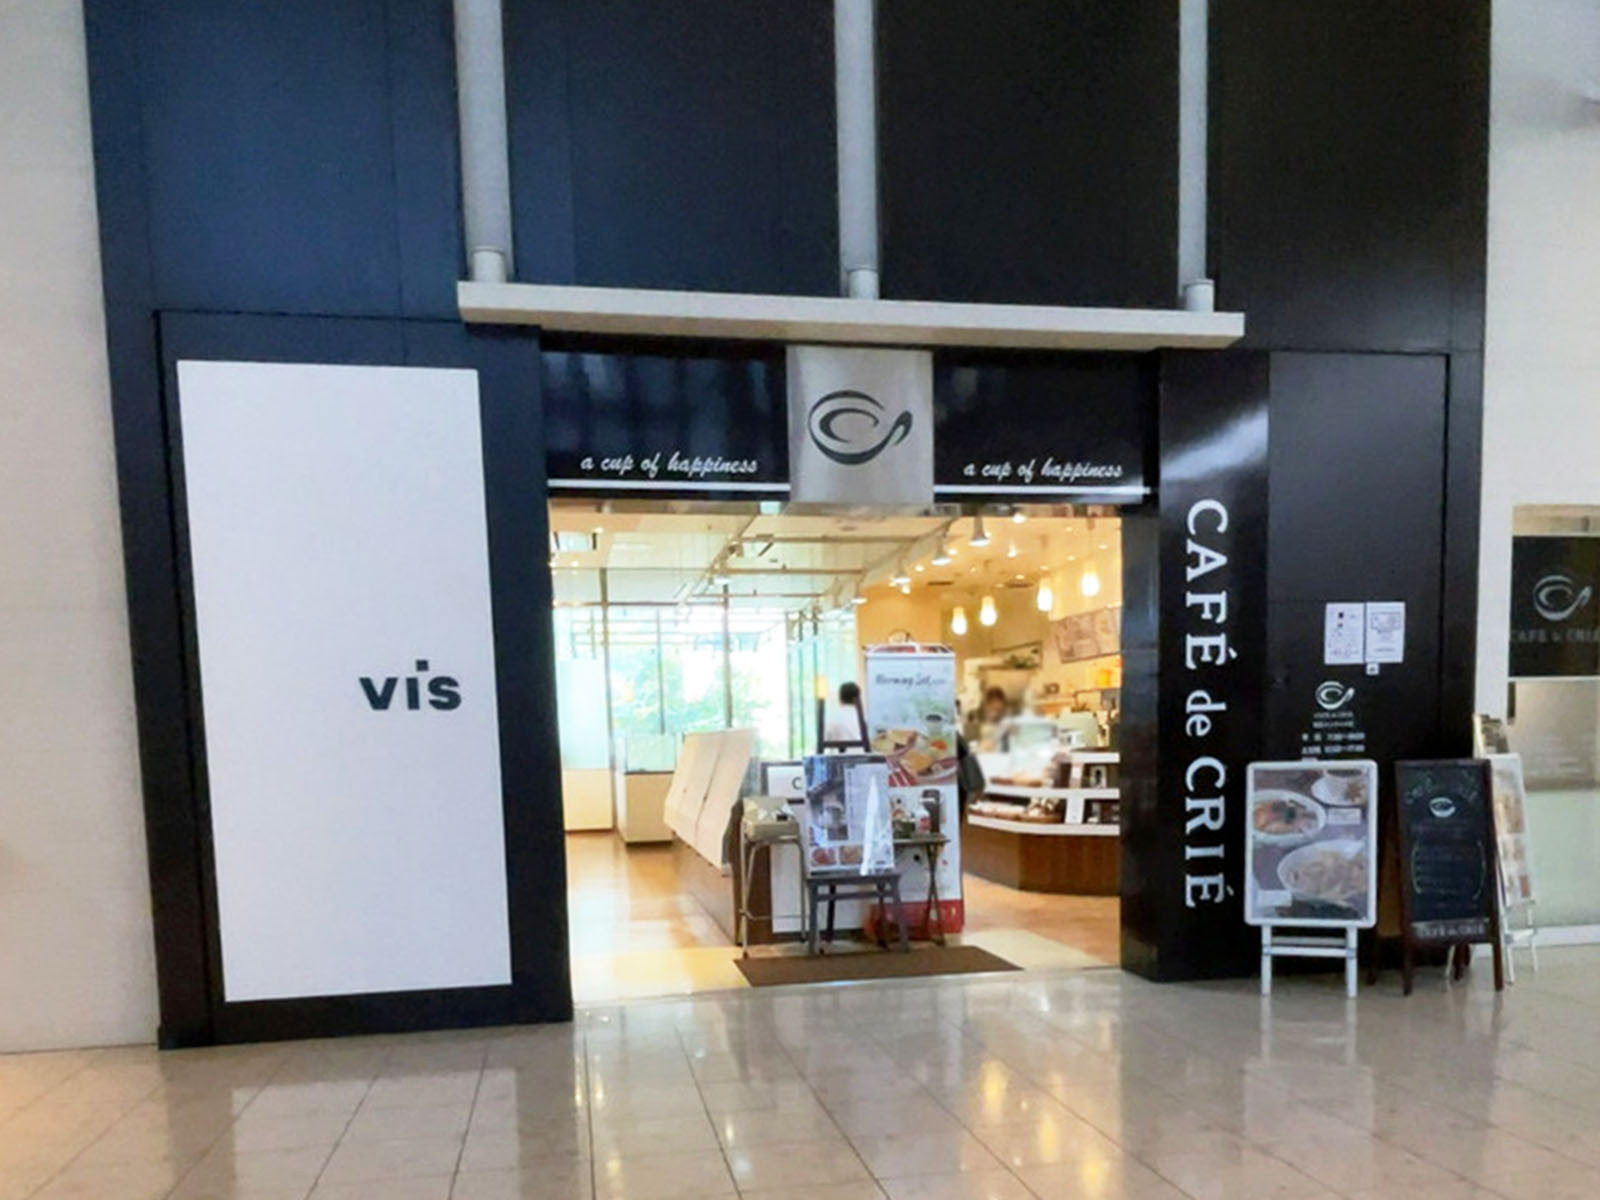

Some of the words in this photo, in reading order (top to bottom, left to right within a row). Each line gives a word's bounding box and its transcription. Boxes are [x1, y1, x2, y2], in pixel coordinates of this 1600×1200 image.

[580, 457, 594, 470] a
[601, 454, 634, 476] cup
[640, 452, 661, 478] of
[667, 451, 757, 477] happiness
[963, 463, 976, 476] a
[981, 461, 1011, 482] cup
[1017, 459, 1036, 483] of
[1041, 457, 1122, 482] happiness
[1185, 499, 1238, 670] CAFÉ
[358, 658, 462, 711] vis
[1185, 689, 1227, 737] de
[1184, 756, 1235, 908] CRIÉ
